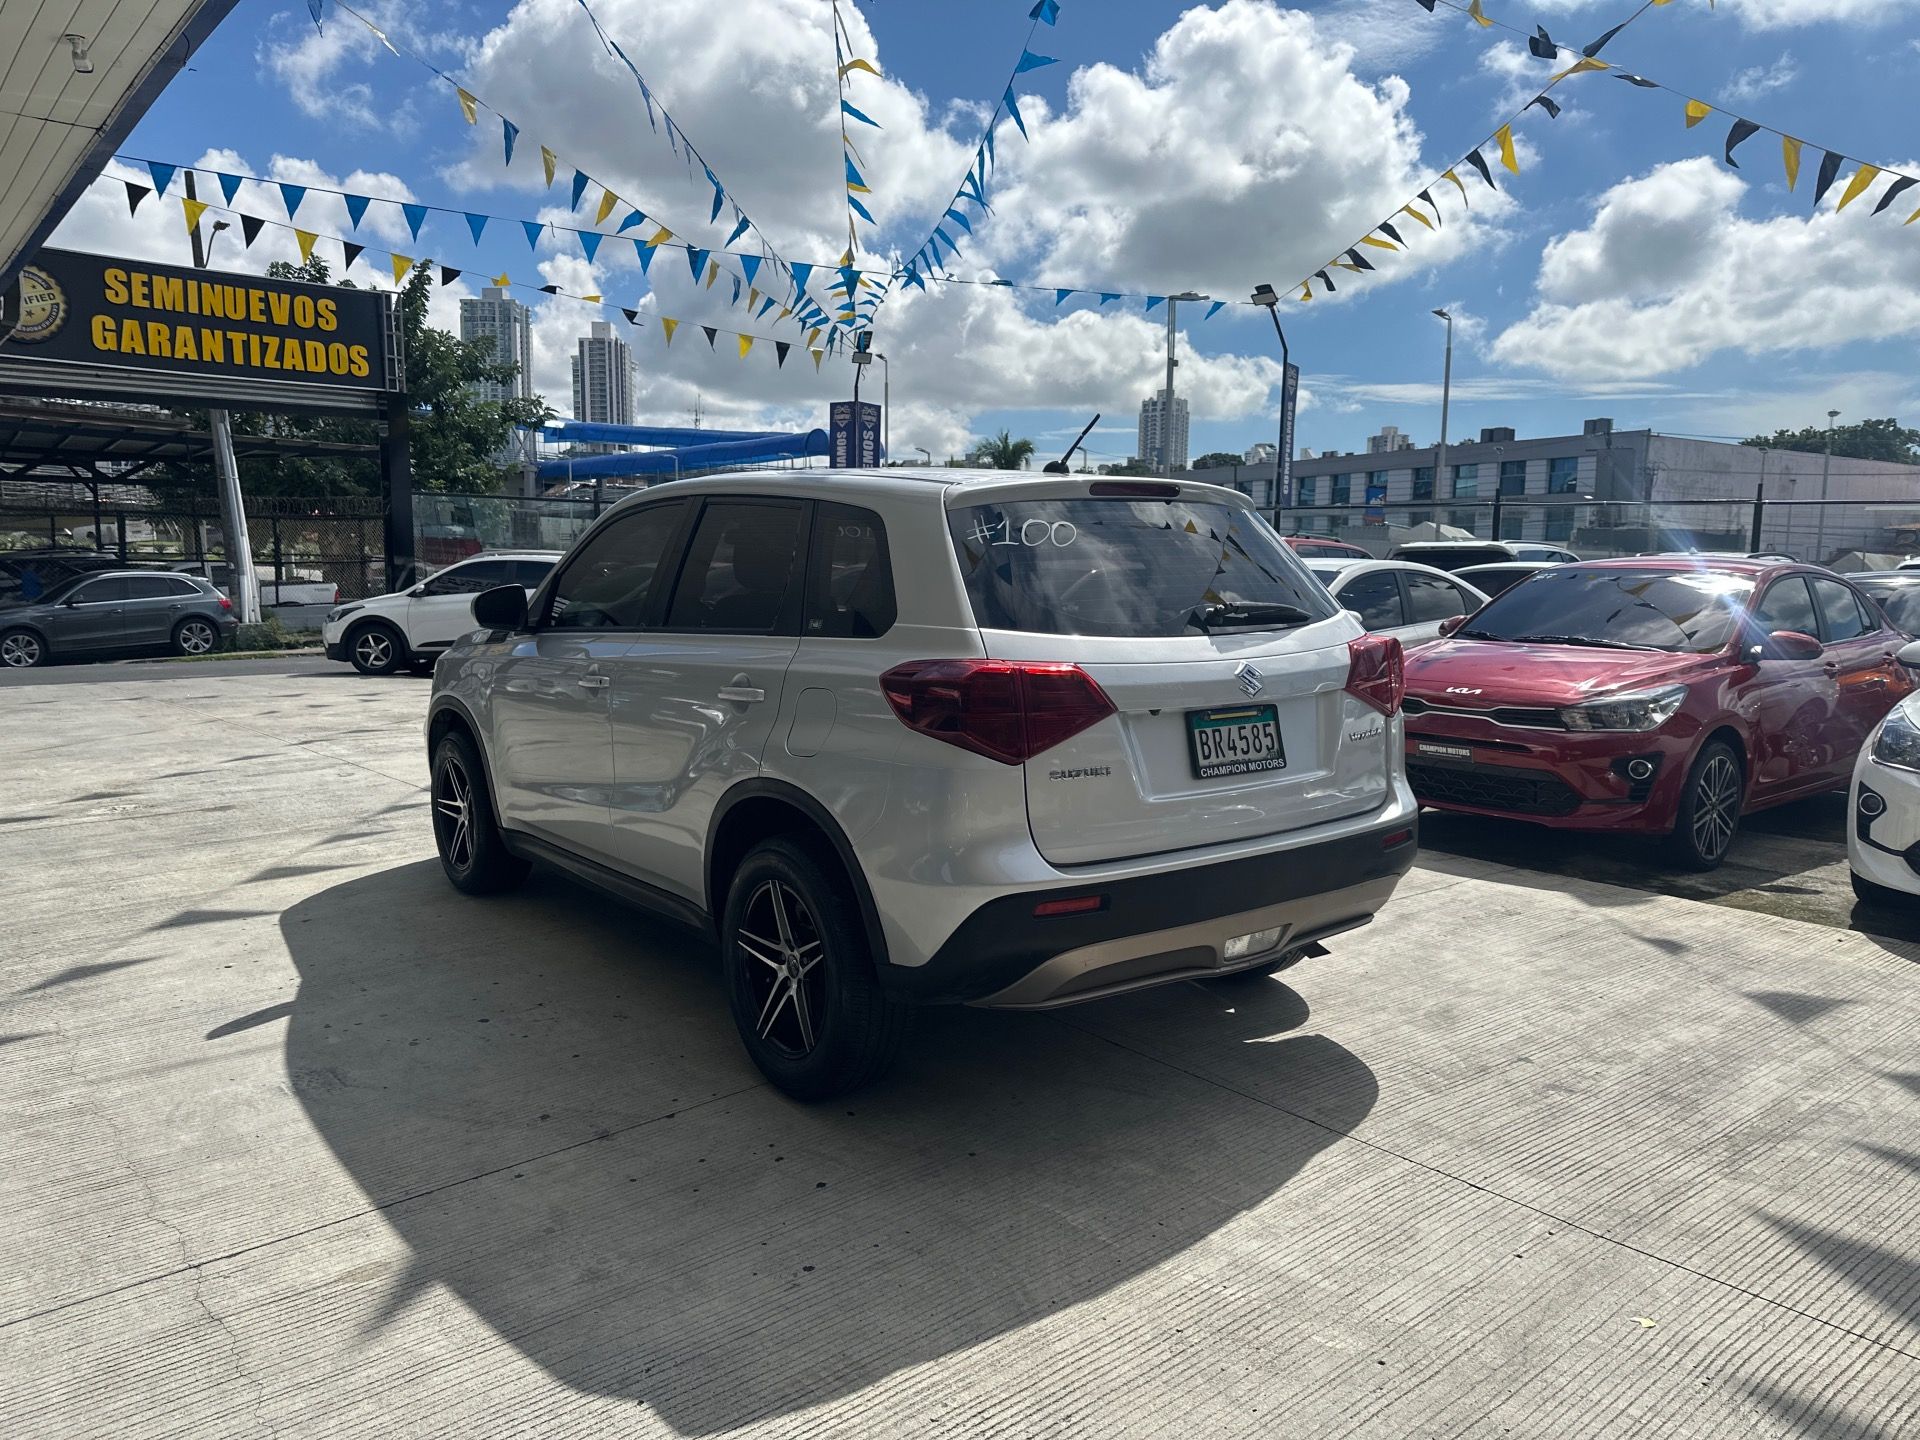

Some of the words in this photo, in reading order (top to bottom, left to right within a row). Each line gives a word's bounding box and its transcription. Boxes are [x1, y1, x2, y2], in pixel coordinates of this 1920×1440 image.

[103, 268, 338, 332] SEMINUEVOS
[90, 315, 370, 377] GARANTIZADOS
[966, 515, 1077, 547] #100
[1199, 723, 1275, 760] BR4585
[1419, 743, 1447, 753] CHAMPION
[1448, 747, 1470, 756] MOTORS
[1200, 764, 1247, 777] CHAMPION
[1249, 758, 1285, 771] MOTORS
